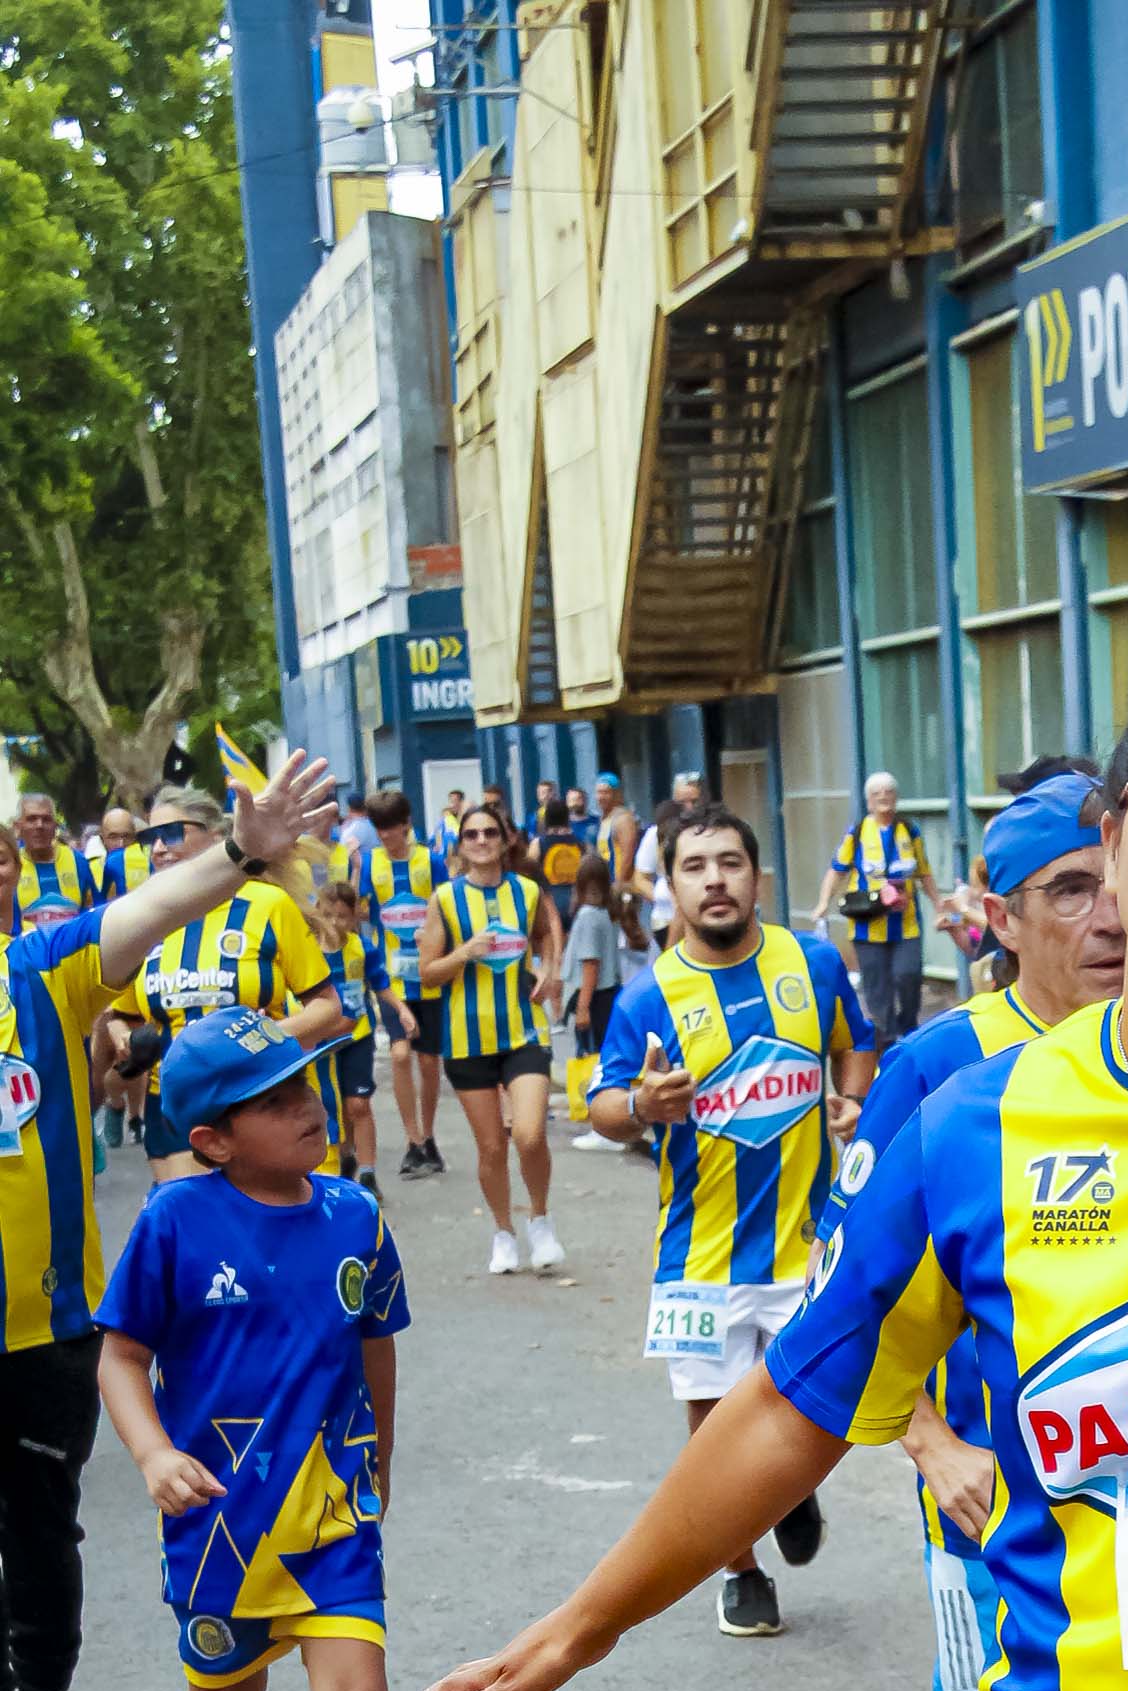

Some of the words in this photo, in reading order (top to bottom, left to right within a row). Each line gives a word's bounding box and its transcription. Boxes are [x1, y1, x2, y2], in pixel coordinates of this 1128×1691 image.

[406, 636, 440, 676] 10
[694, 1066, 820, 1118] PALADINI
[1029, 1151, 1111, 1203] 17
[1032, 1206, 1112, 1221] MARATÓN
[1033, 1221, 1110, 1232] CANALLA
[653, 1309, 716, 1338] 2118
